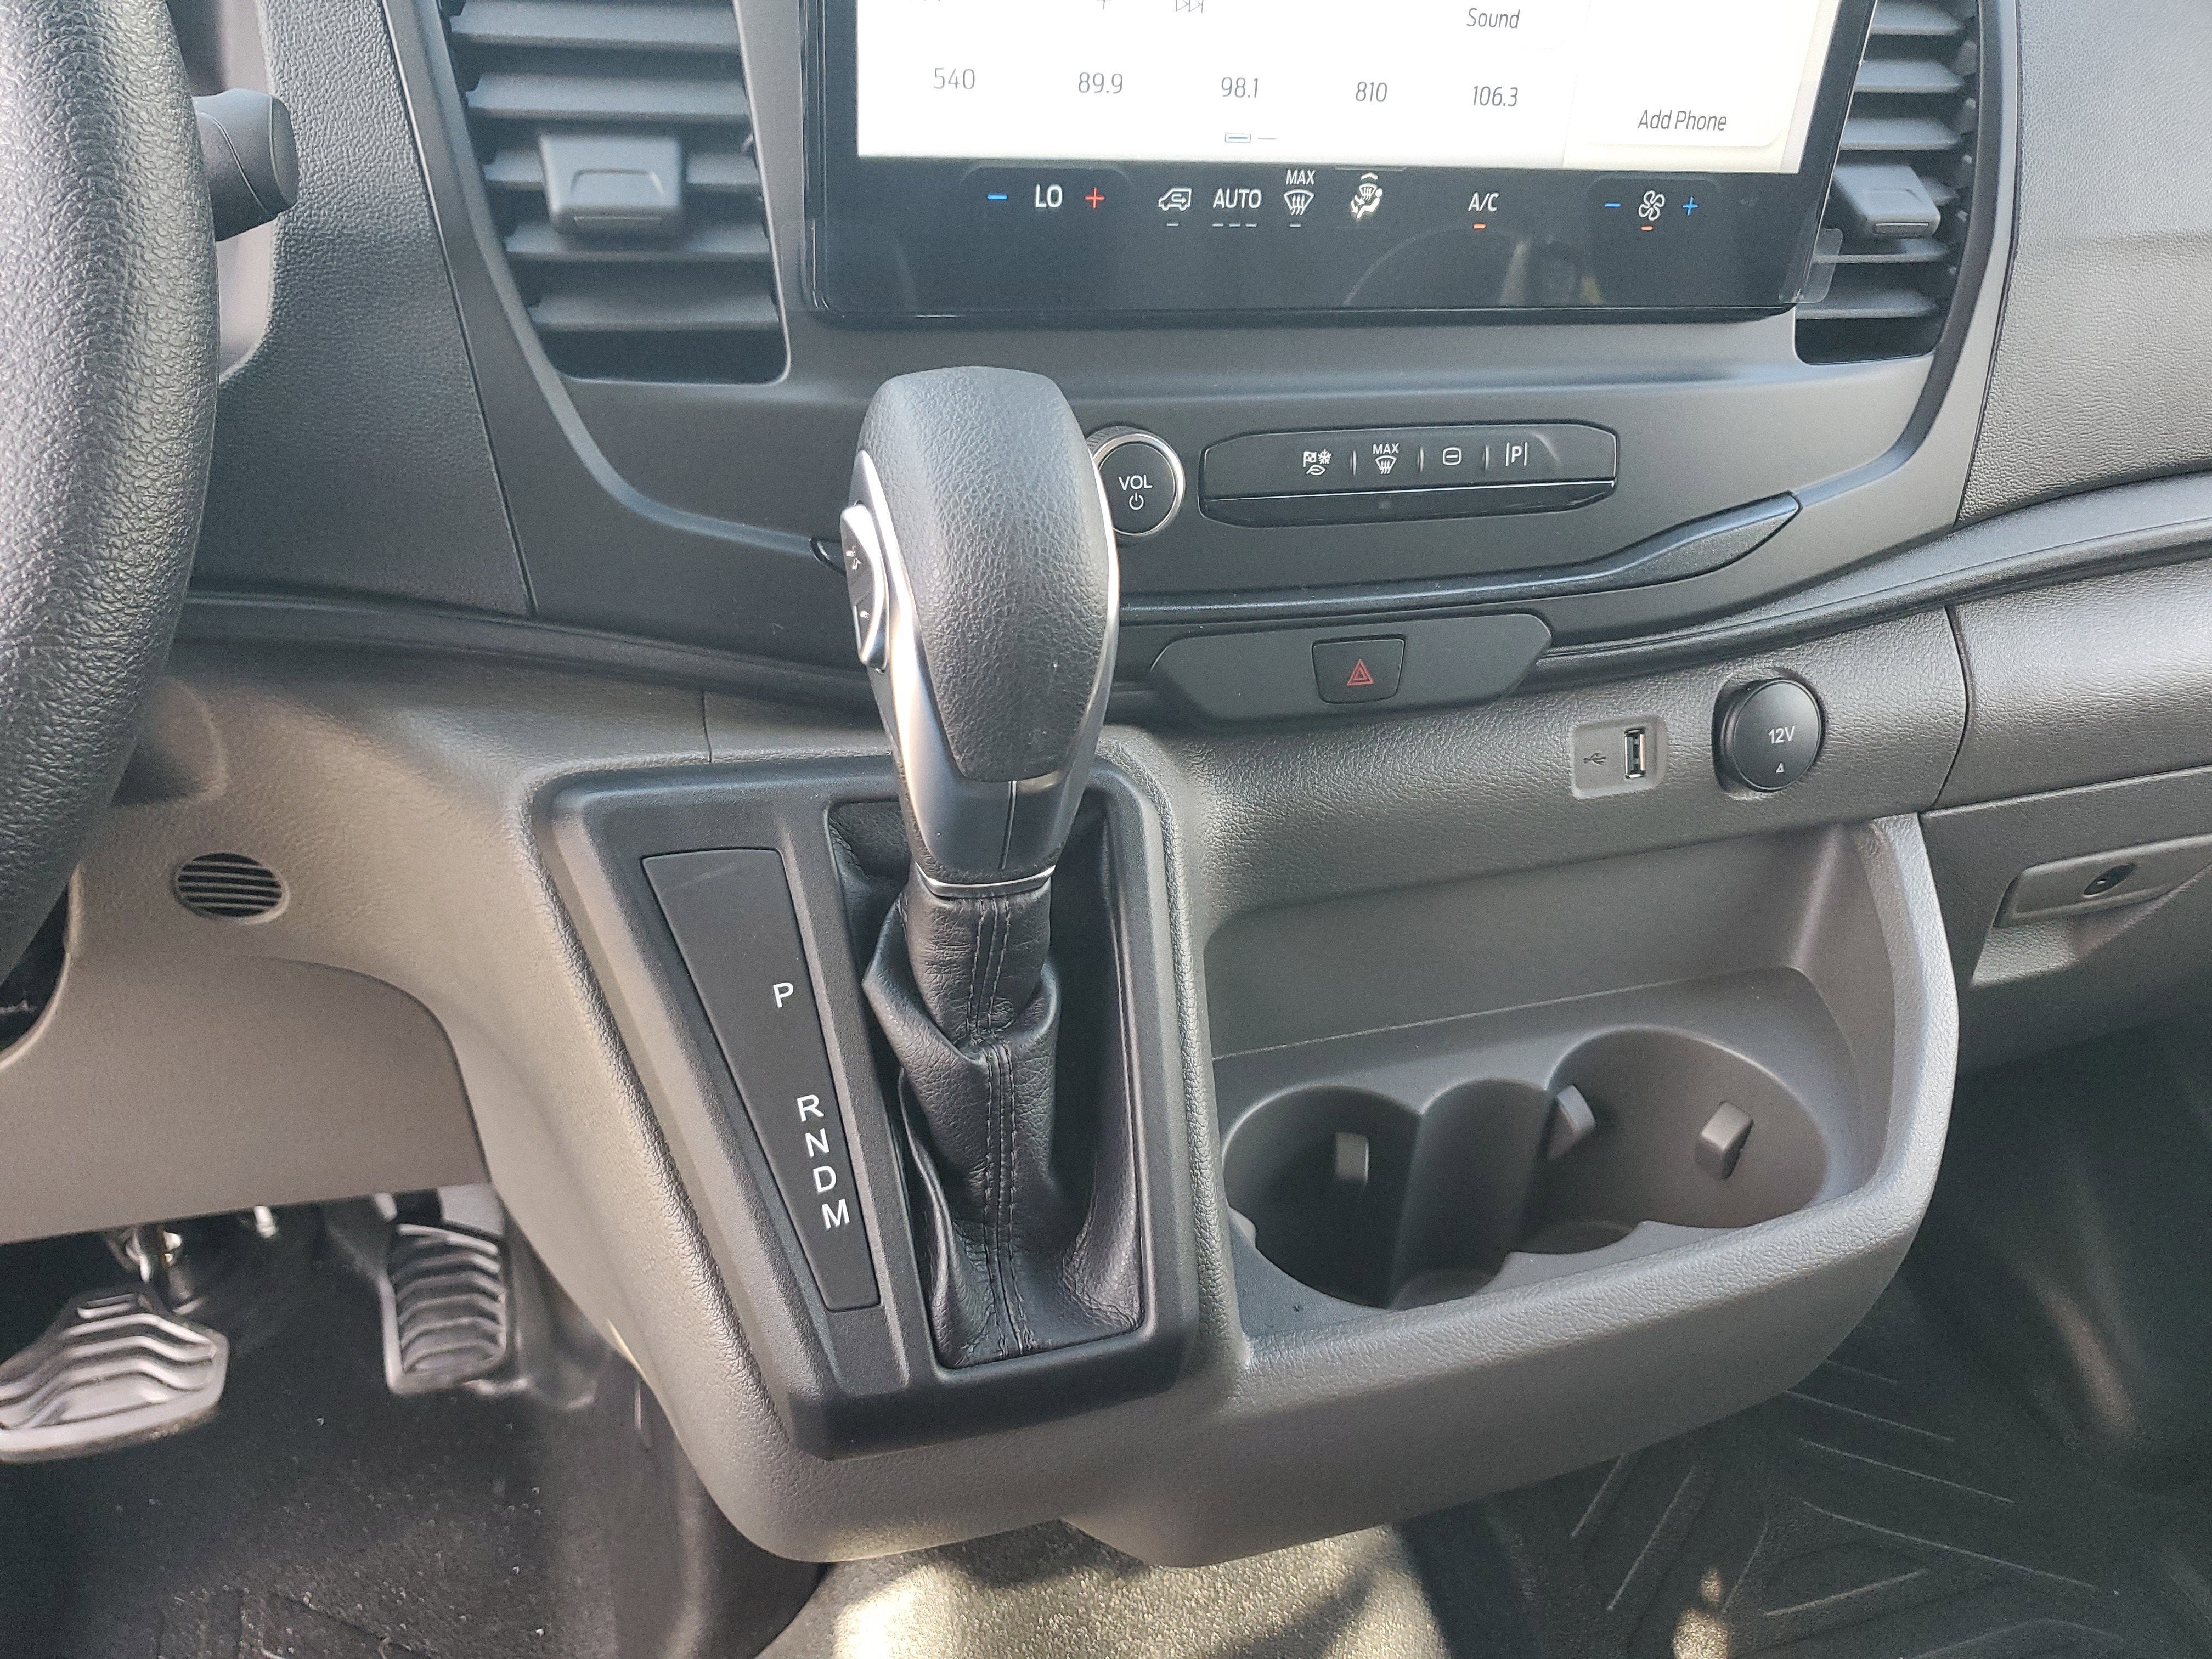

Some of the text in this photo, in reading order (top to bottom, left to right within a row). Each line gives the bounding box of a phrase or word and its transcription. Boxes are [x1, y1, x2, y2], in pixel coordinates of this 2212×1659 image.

[1466, 7, 1521, 29] Sound
[934, 67, 975, 90] 540
[1078, 72, 1123, 94] 89.9
[1221, 77, 1259, 98] 98.1
[1355, 81, 1387, 103] 810
[1473, 86, 1519, 107] 106.3
[1637, 109, 1727, 132] Add Phone
[1286, 169, 1316, 185] MAX
[1035, 184, 1063, 208] LO
[1212, 188, 1262, 210] AUTO
[1468, 192, 1499, 212] A/C
[1373, 443, 1400, 455] MAX
[1118, 475, 1153, 490] VOL
[1768, 725, 1796, 744] 12V
[772, 982, 794, 1008] P
[797, 1094, 825, 1122] R
[805, 1128, 830, 1158] N
[812, 1165, 837, 1193] D
[822, 1198, 850, 1229] M
